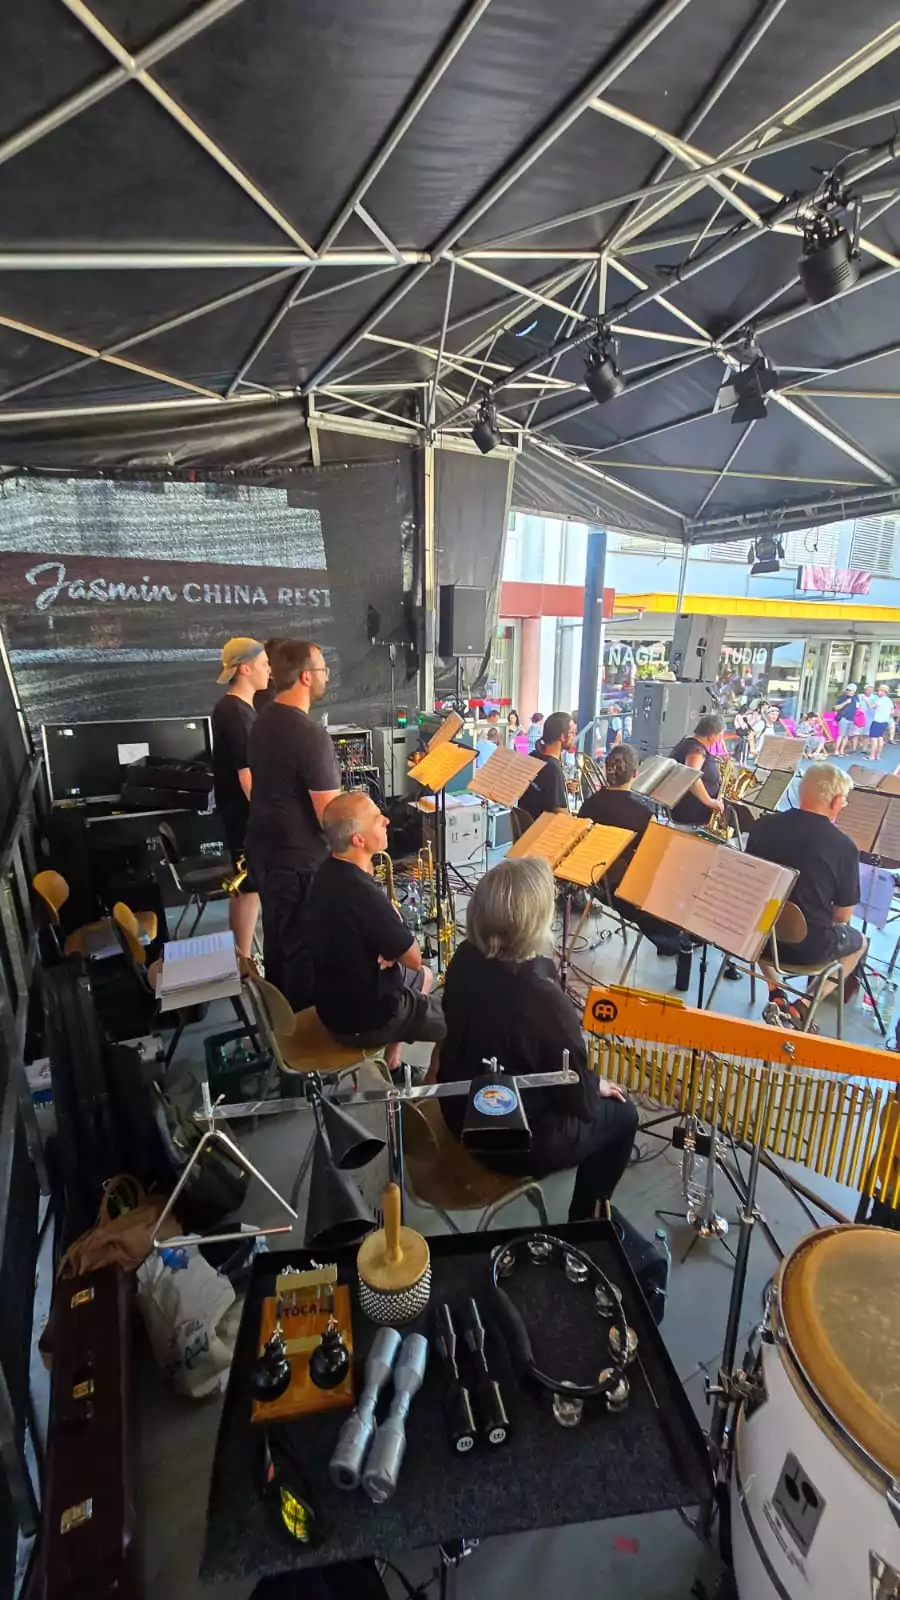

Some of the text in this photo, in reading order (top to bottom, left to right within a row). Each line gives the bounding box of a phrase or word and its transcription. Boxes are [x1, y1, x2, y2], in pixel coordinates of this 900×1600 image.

[25, 561, 331, 610] Jasmin CHINA REST
[719, 647, 767, 665] TUDIO
